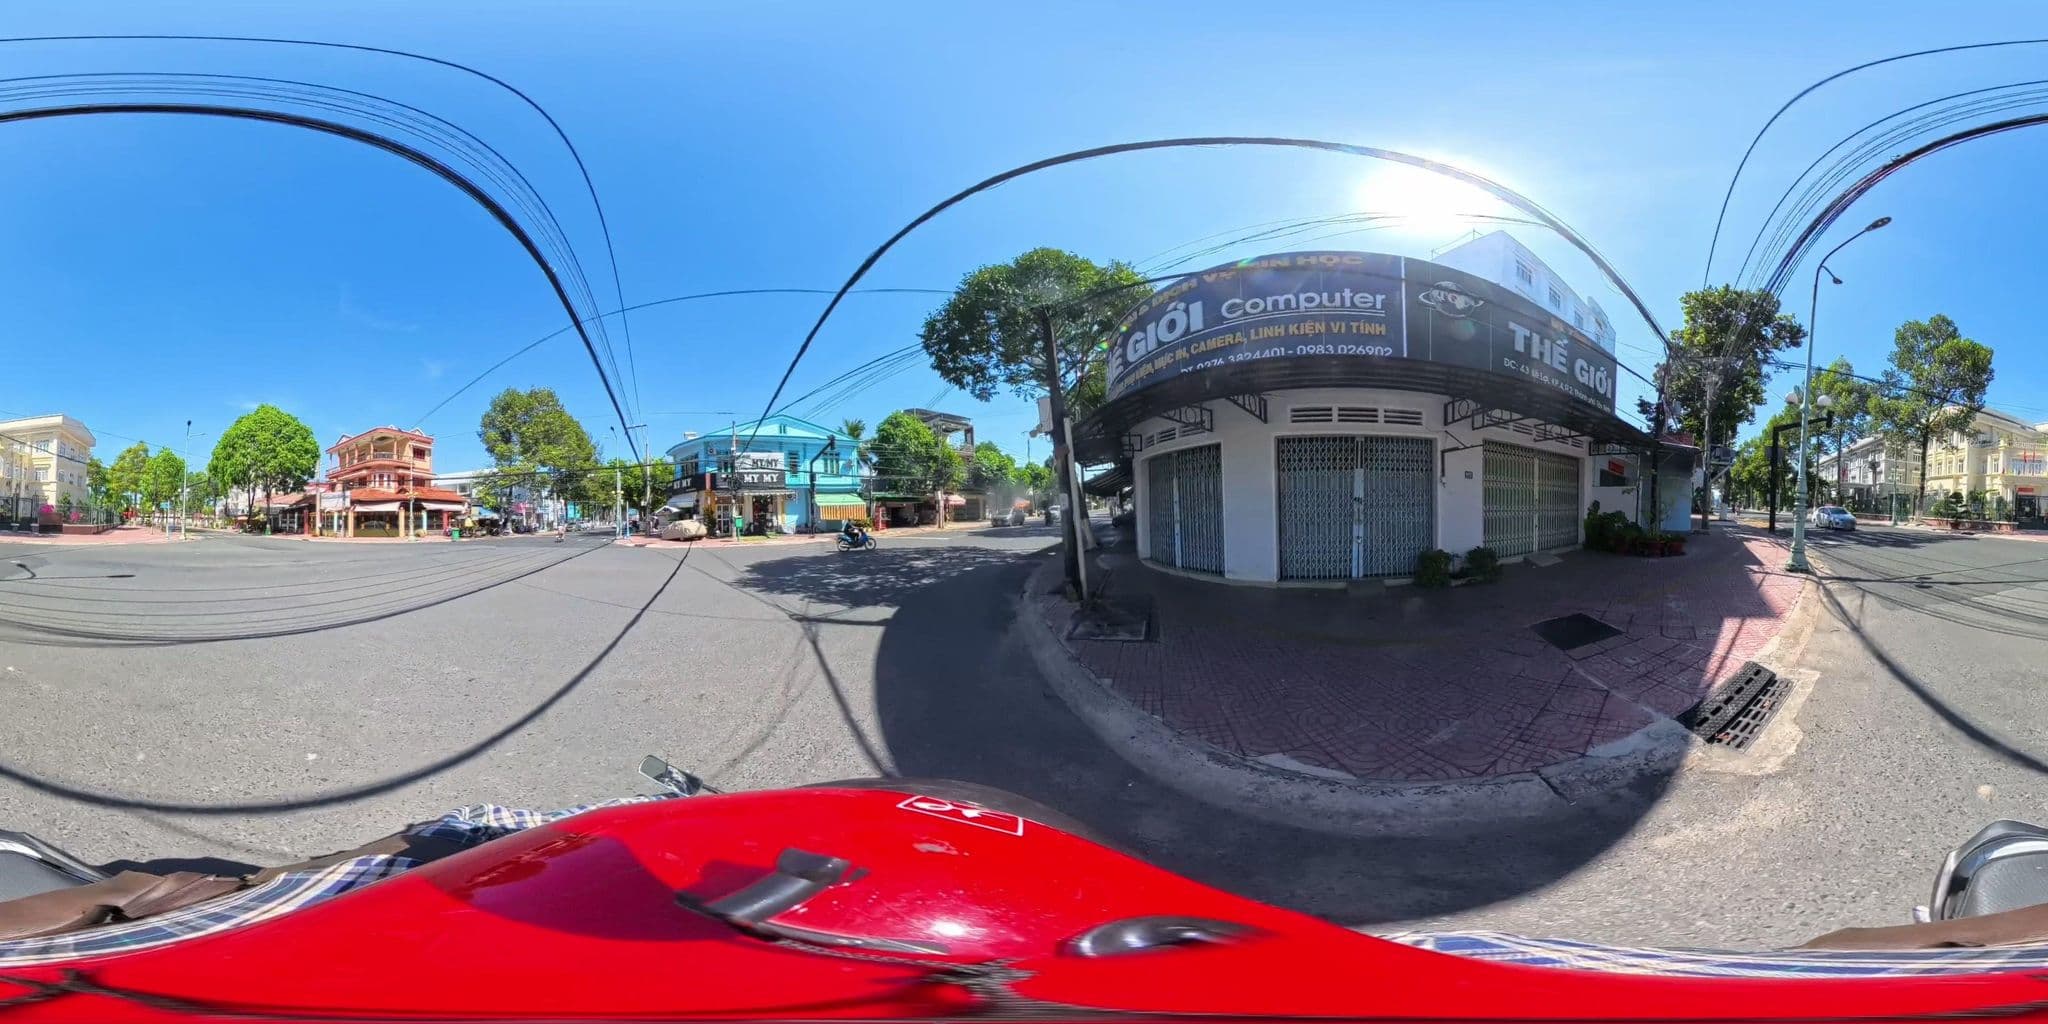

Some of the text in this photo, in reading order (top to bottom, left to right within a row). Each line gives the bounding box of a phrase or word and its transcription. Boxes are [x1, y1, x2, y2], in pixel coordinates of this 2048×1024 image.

[1296, 254, 1363, 267] HỌC
[1126, 300, 1204, 362] GIỚI
[1221, 288, 1386, 319] Computer
[1190, 331, 1248, 354] CAMERA,
[1250, 324, 1285, 340] LINH
[1289, 320, 1326, 337] KIỆN
[1330, 321, 1346, 334] VI
[1350, 320, 1387, 336] TÍNH
[1296, 344, 1335, 356] 0983
[1508, 321, 1569, 374] THẾ
[1574, 358, 1612, 399] GIỚI
[743, 473, 779, 483] MY MY
